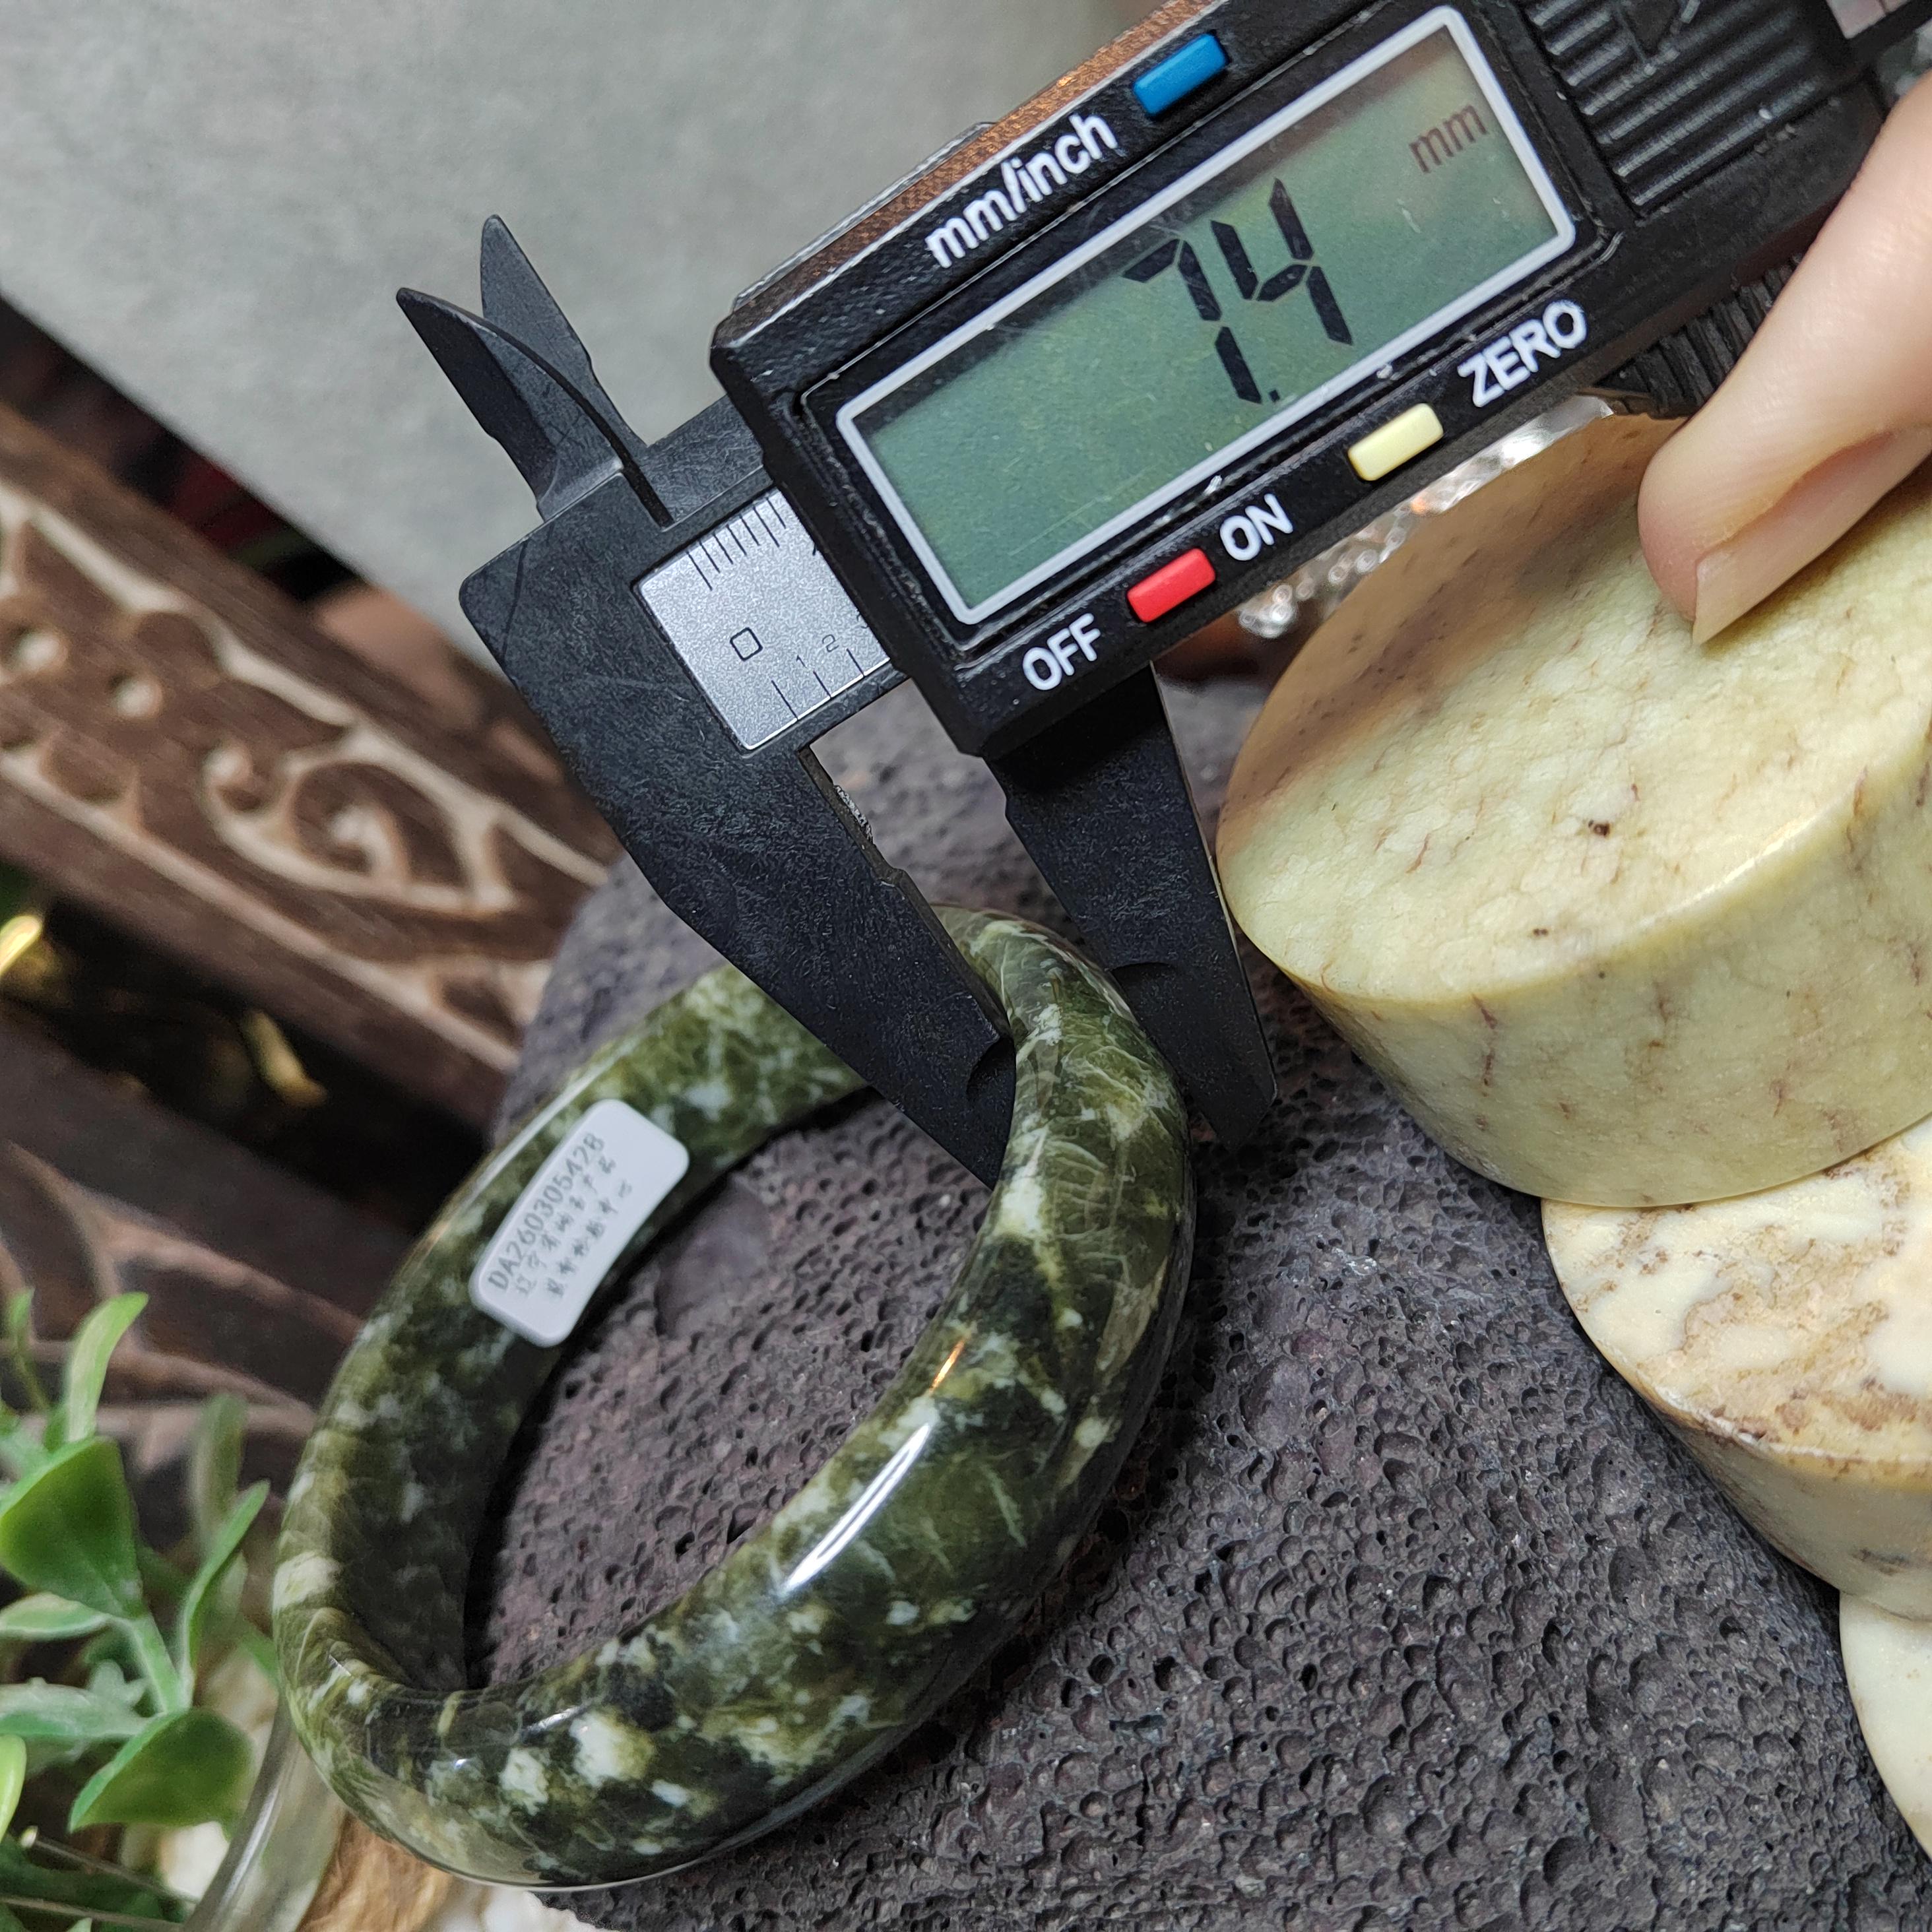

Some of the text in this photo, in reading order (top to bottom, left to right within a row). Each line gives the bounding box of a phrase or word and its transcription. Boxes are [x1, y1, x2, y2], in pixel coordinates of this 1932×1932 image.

[925, 112, 1118, 269] mm/inch
[1123, 102, 1487, 405] 7.4 mm
[1457, 300, 1588, 408] ZERO
[1219, 492, 1295, 563] ON
[821, 633, 840, 653] 2
[1021, 612, 1102, 692] OFF
